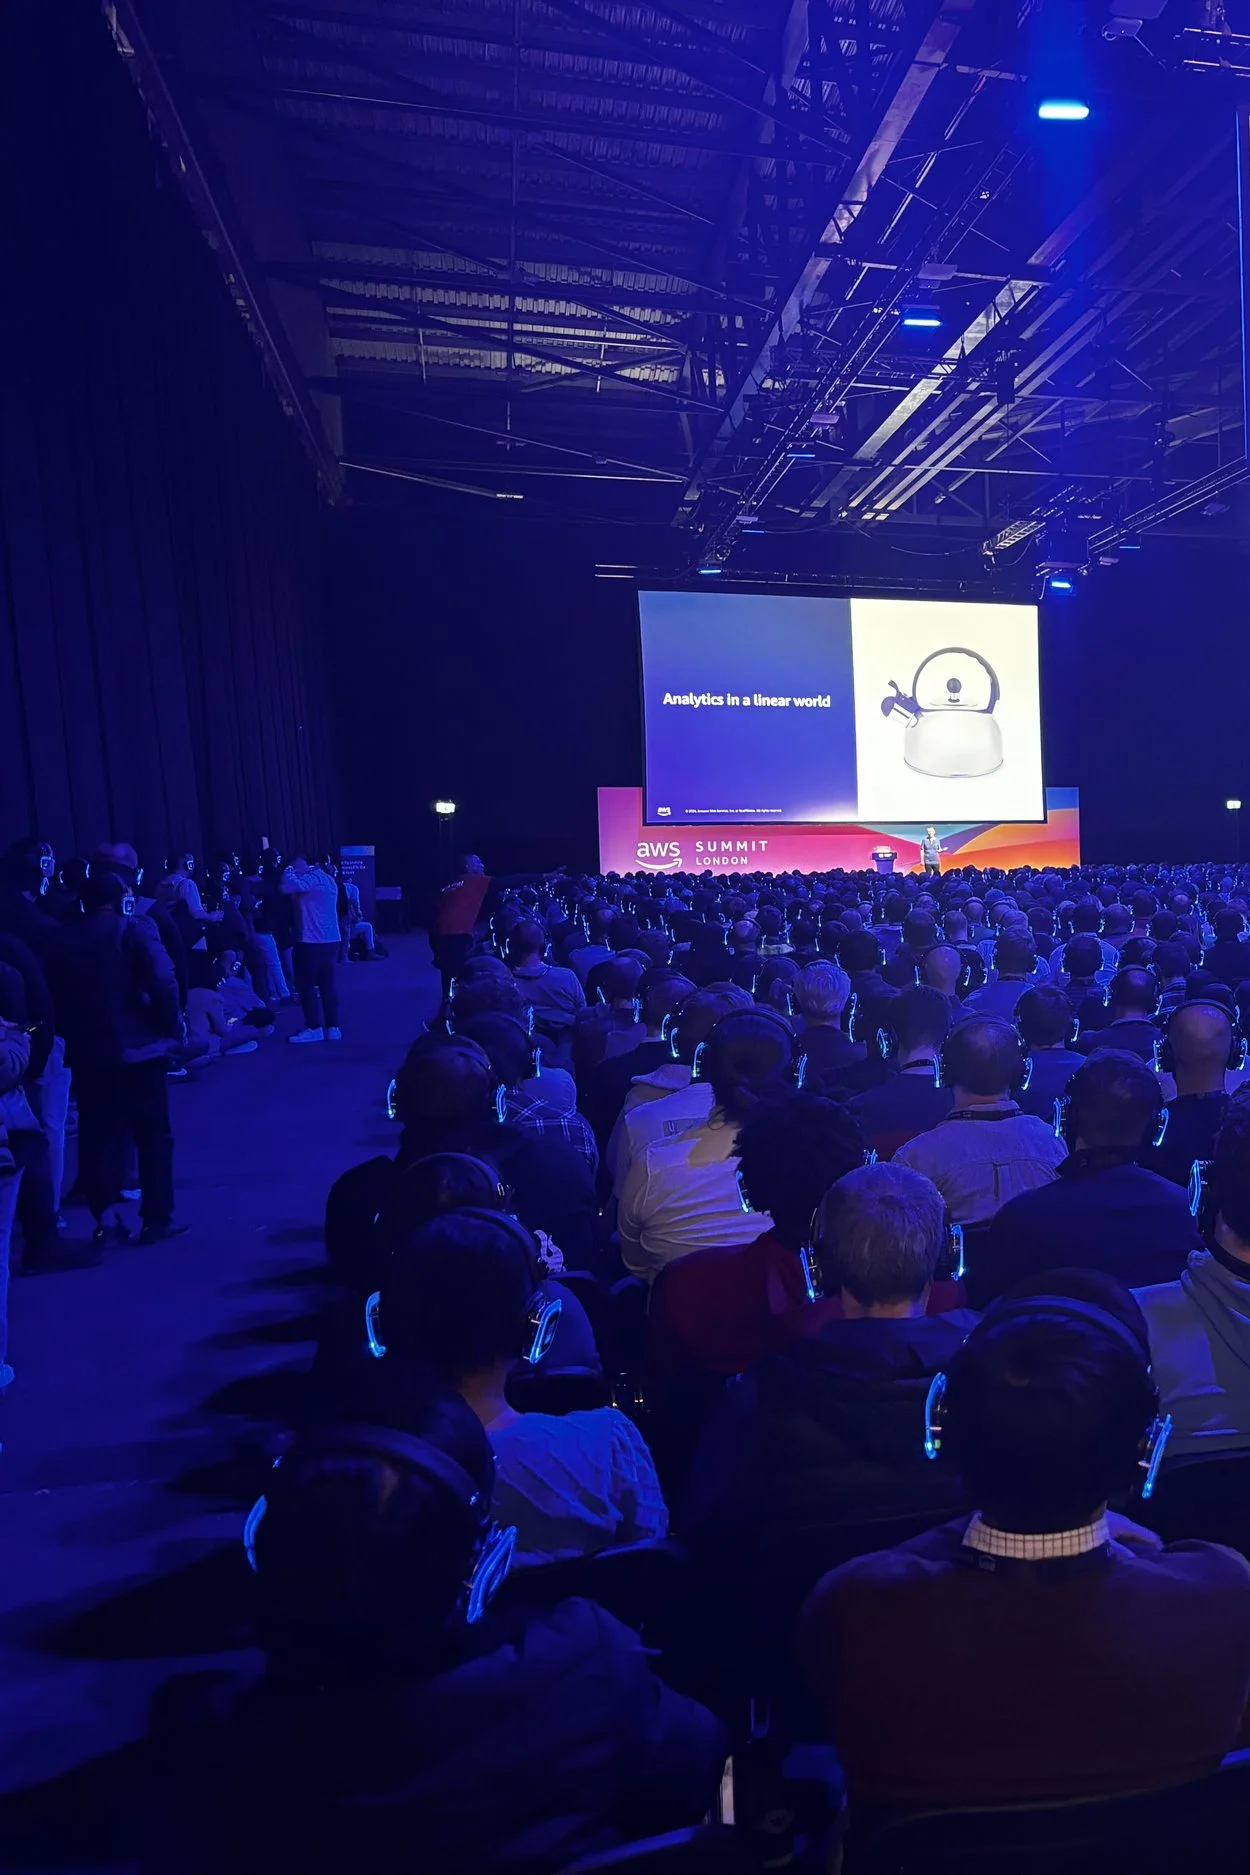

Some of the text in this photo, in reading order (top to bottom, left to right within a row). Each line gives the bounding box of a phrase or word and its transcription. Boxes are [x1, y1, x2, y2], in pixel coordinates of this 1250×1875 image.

[663, 692, 831, 708] Analytics in a linear world
[637, 840, 768, 858] aws SUMMIT
[696, 856, 748, 866] LONDON
